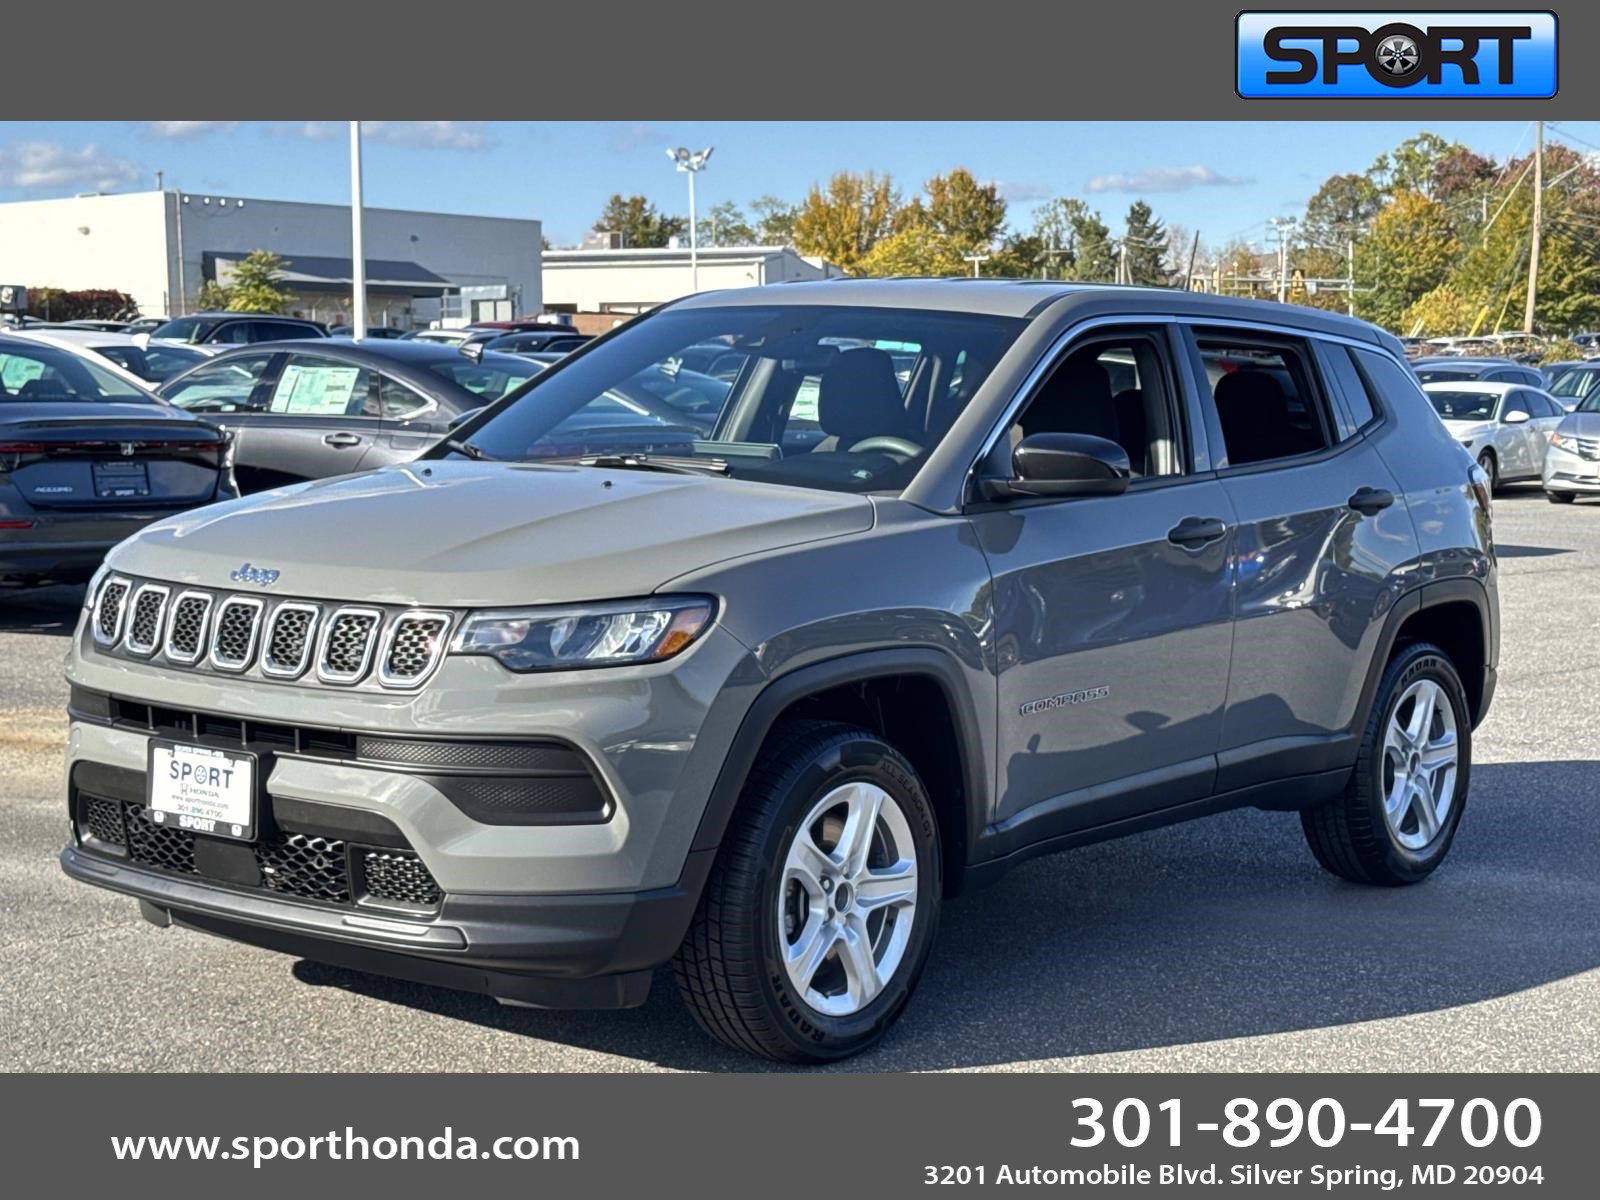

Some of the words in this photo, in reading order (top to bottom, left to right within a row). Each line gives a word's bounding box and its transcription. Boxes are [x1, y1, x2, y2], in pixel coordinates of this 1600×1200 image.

[230, 562, 281, 587] Jeep
[1019, 685, 1110, 716] COMPASS
[168, 759, 234, 789] SPORT
[179, 815, 217, 832] SPORT
[771, 974, 826, 1042] RADAR
